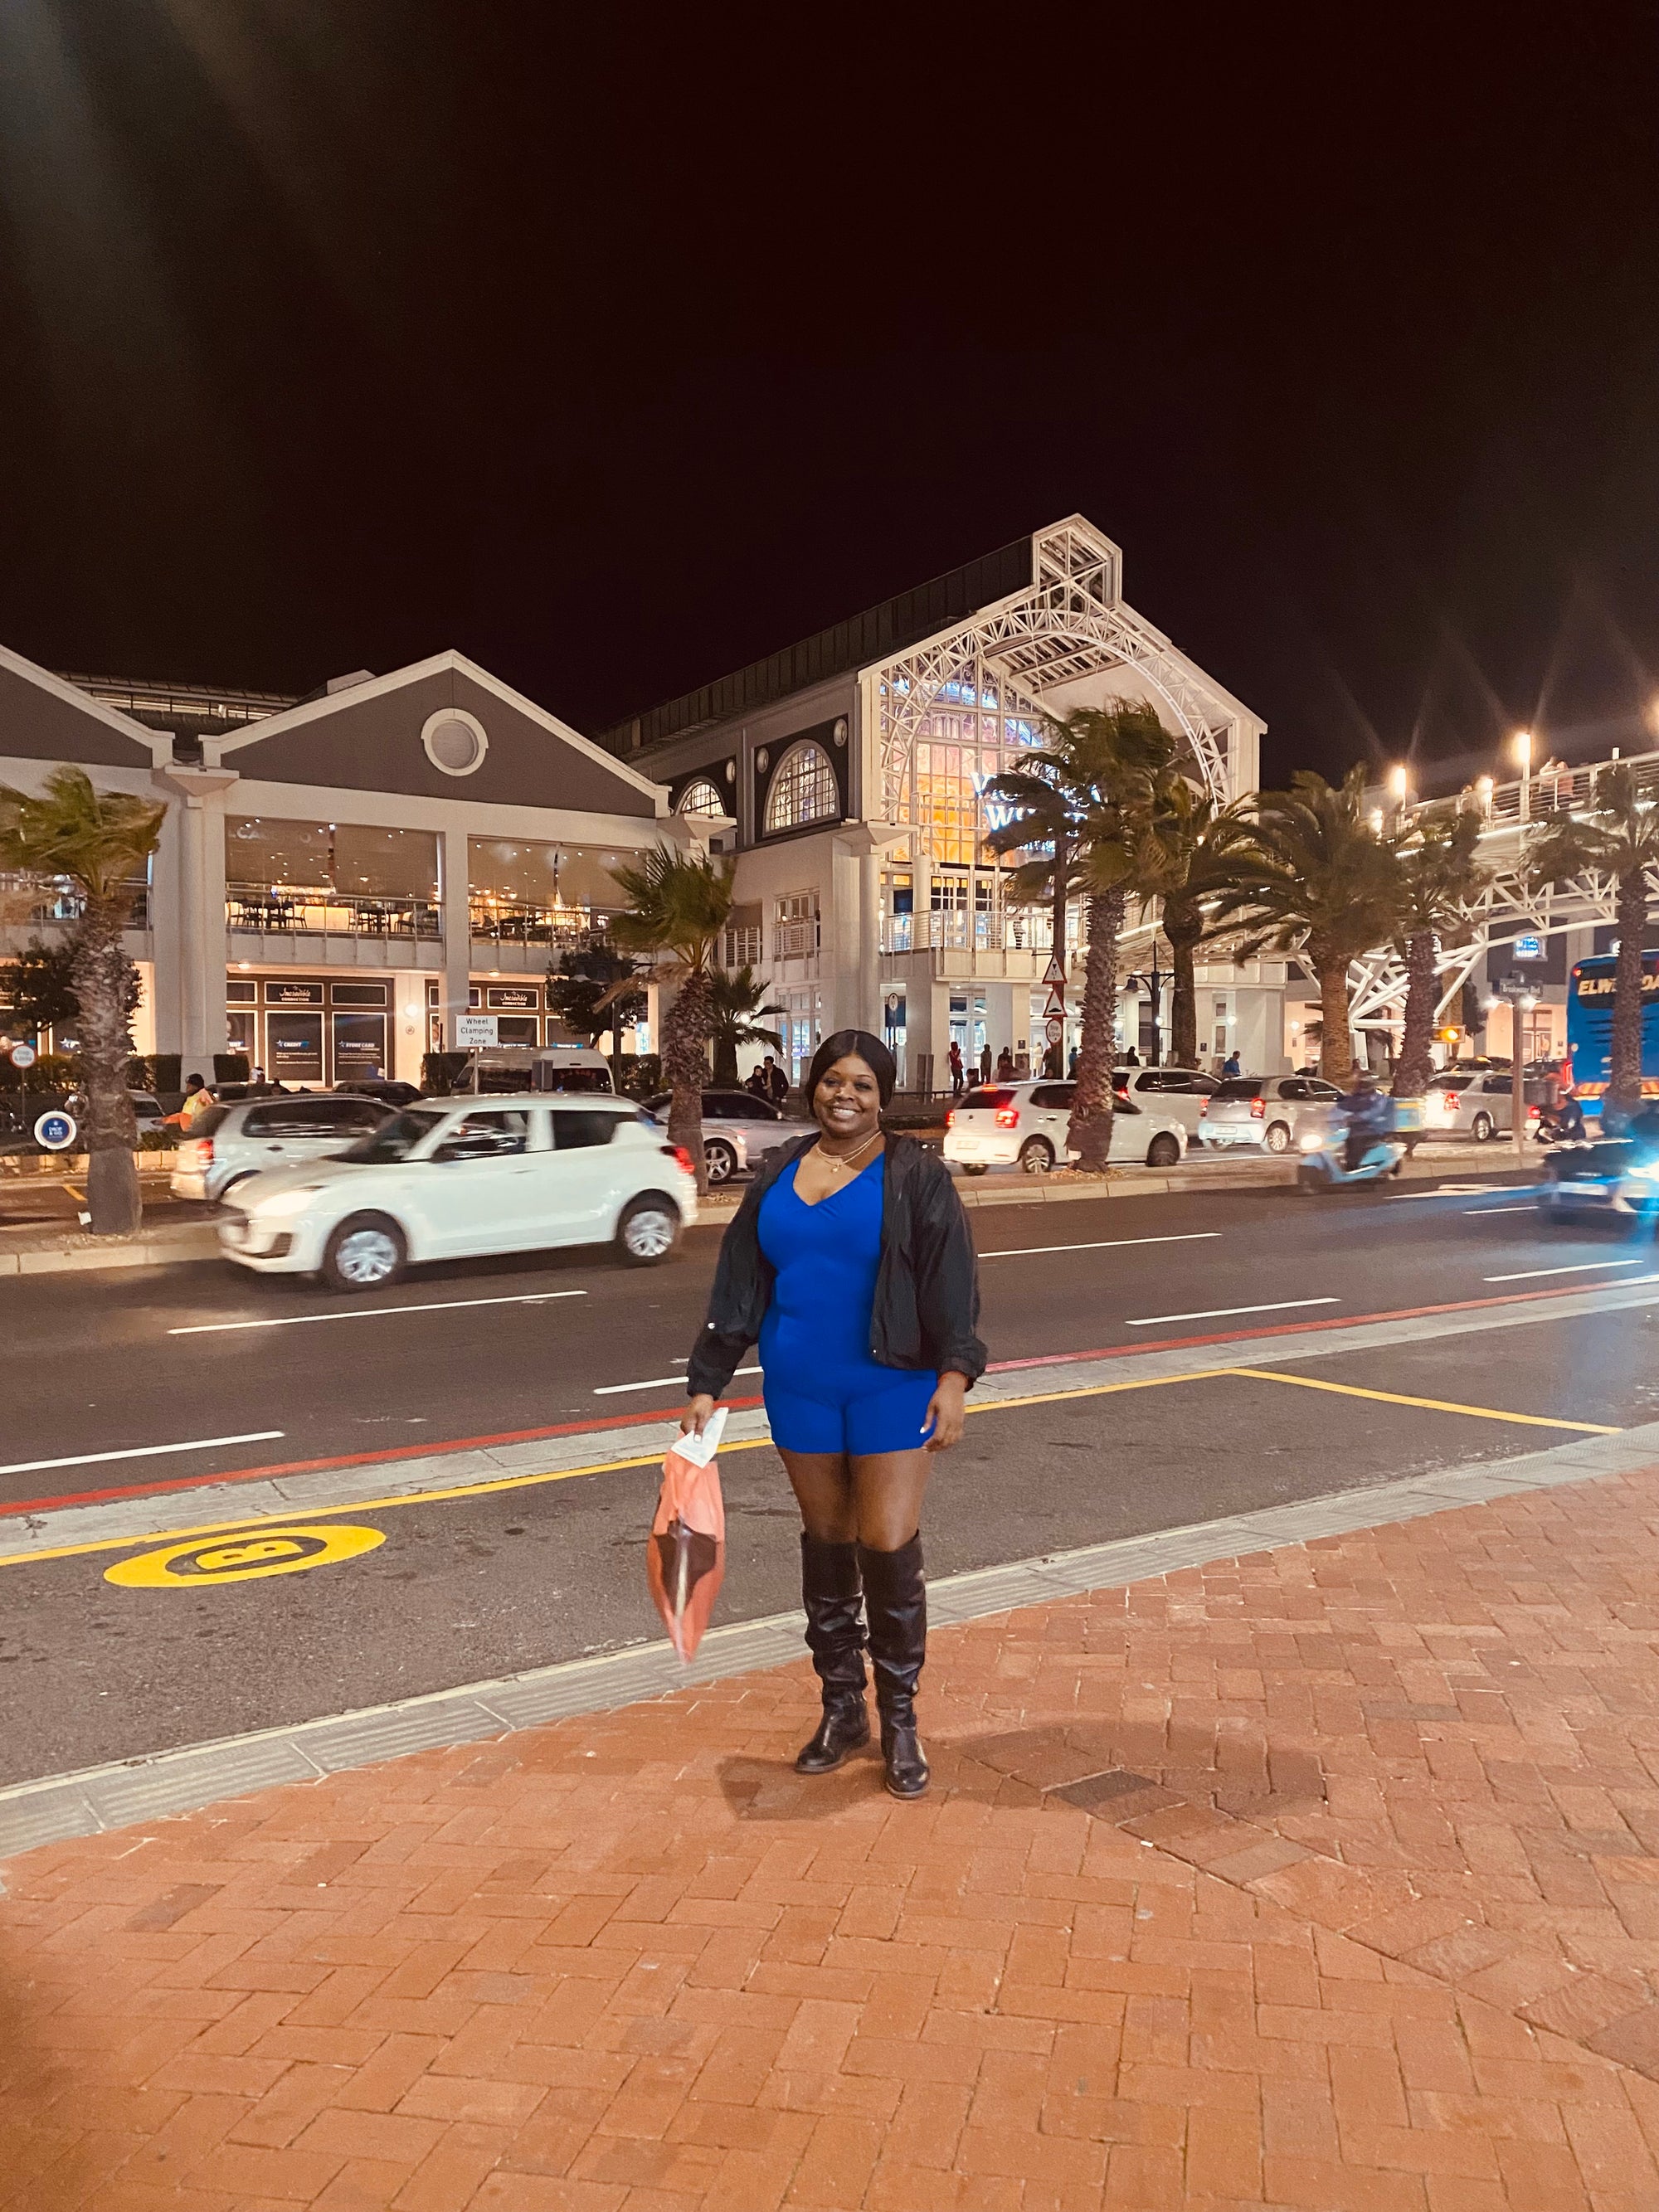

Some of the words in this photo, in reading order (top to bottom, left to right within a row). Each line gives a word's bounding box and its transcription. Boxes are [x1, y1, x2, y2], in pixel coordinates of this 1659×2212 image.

[279, 987, 311, 997] Incredible
[1502, 984, 1530, 994] Breakwater
[1530, 984, 1540, 994] Blvd
[499, 992, 528, 1002] Incredible
[460, 1027, 494, 1036] Clamping
